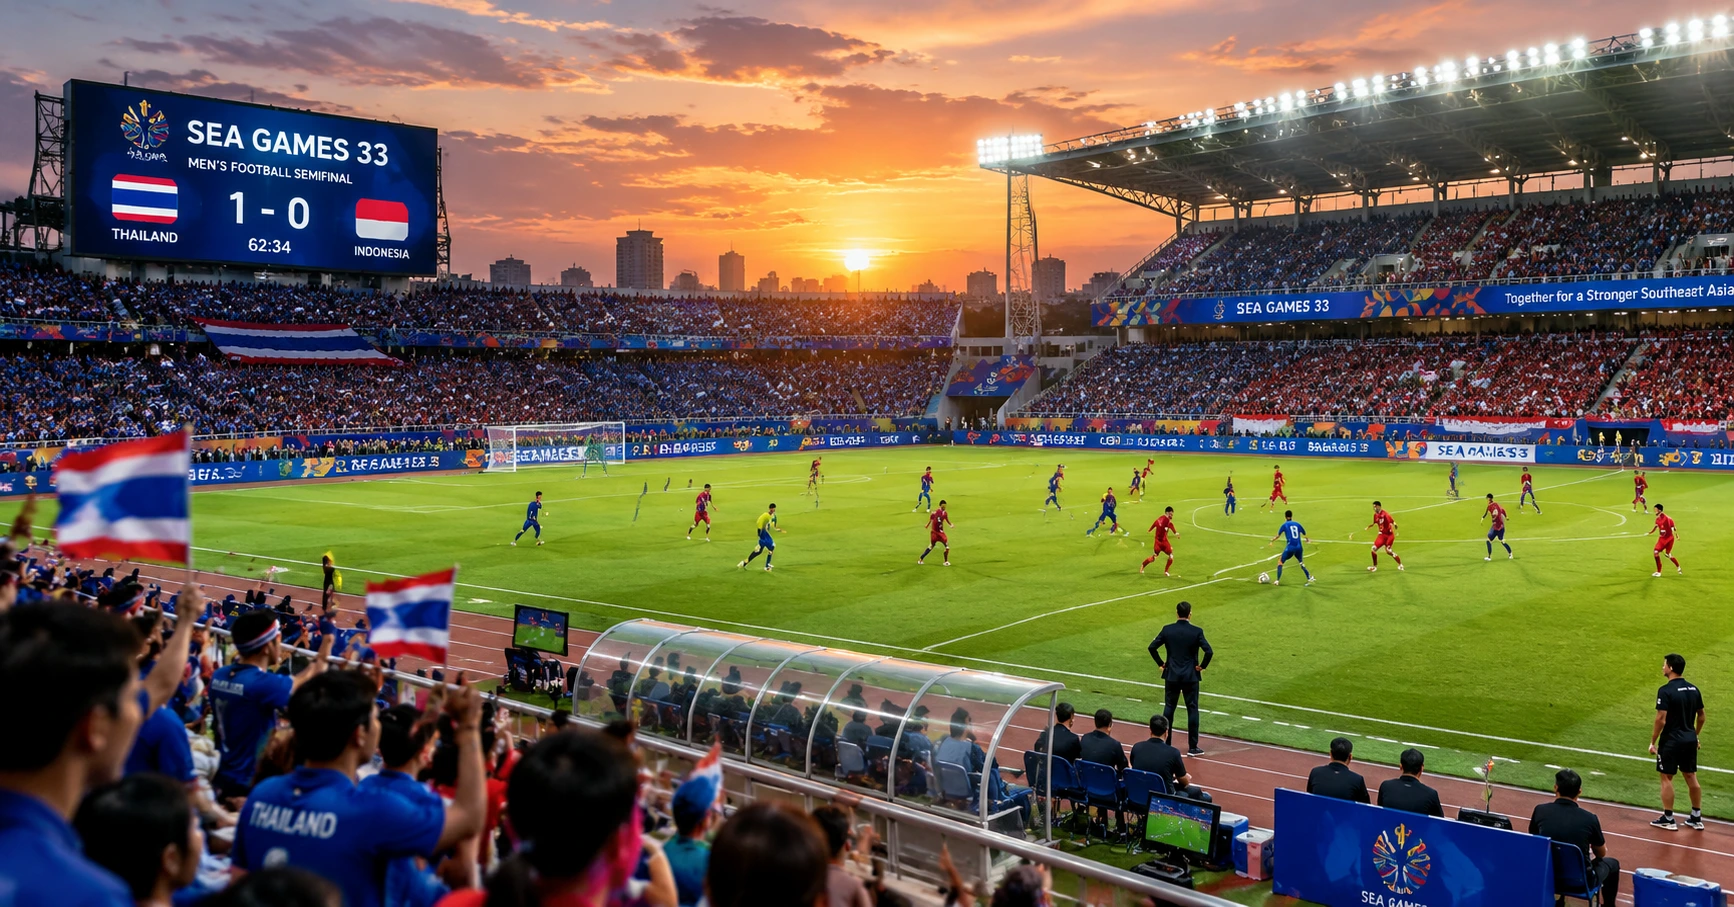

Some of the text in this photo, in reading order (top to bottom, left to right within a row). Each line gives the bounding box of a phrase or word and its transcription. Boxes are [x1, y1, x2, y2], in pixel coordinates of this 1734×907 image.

[187, 119, 388, 166] SEA GAMES 33
[188, 157, 353, 185] MEN'S FOOTBALL SEMIFINAL
[229, 191, 244, 225] 1
[288, 196, 310, 230] 0
[111, 228, 178, 243] THAILAND
[248, 238, 291, 254] 62:34
[354, 246, 410, 260] INDONESIA
[1505, 291, 1554, 306] Together
[1557, 290, 1573, 302] for
[1576, 292, 1584, 302] a
[1586, 288, 1638, 303] Stronger
[1707, 283, 1734, 297] Asia
[1236, 299, 1330, 315] SEA GAMES 33
[249, 801, 338, 839] THAILAND
[1361, 890, 1385, 907] SEA
